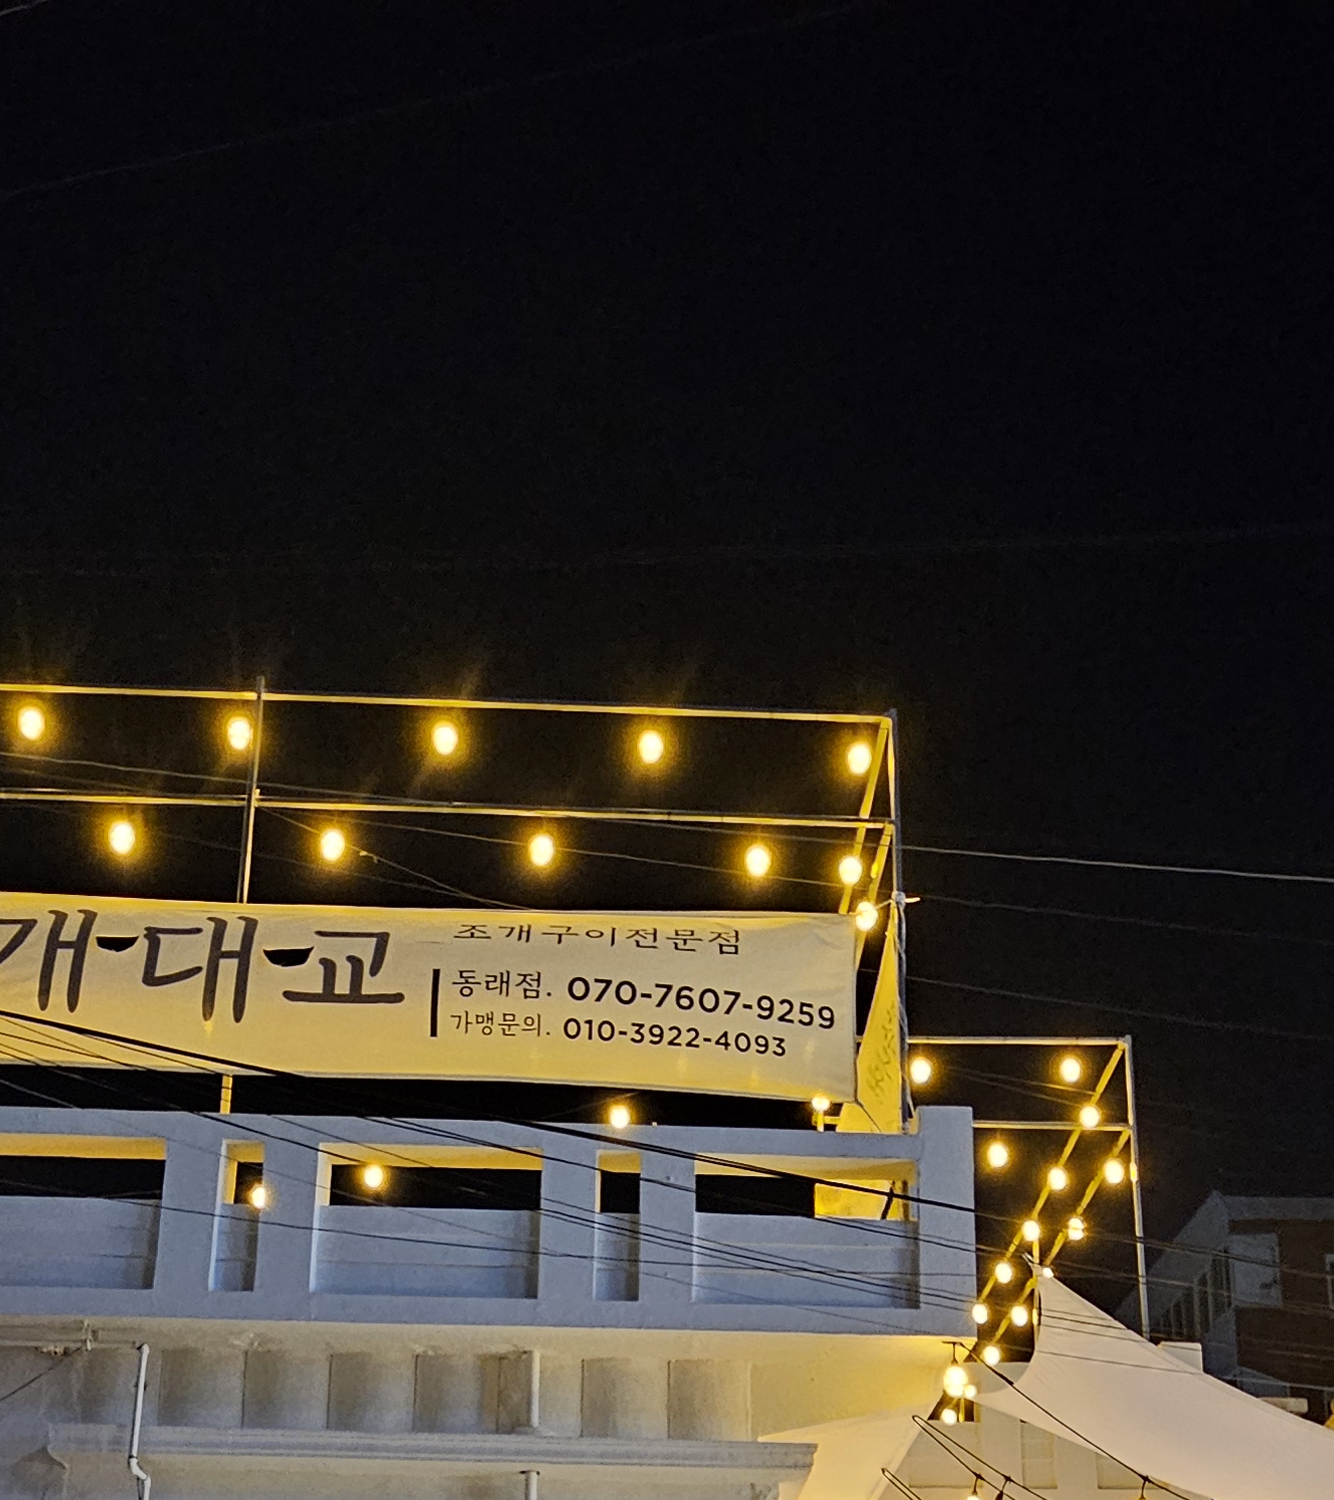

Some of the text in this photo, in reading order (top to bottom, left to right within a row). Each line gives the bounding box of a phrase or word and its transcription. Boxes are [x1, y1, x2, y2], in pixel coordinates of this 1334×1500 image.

[453, 923, 741, 956] 조개구이전문점
[452, 968, 836, 1030] 동래점. 070-7607-9259
[450, 1010, 786, 1057] 가맹문의. 010-3922-4093
